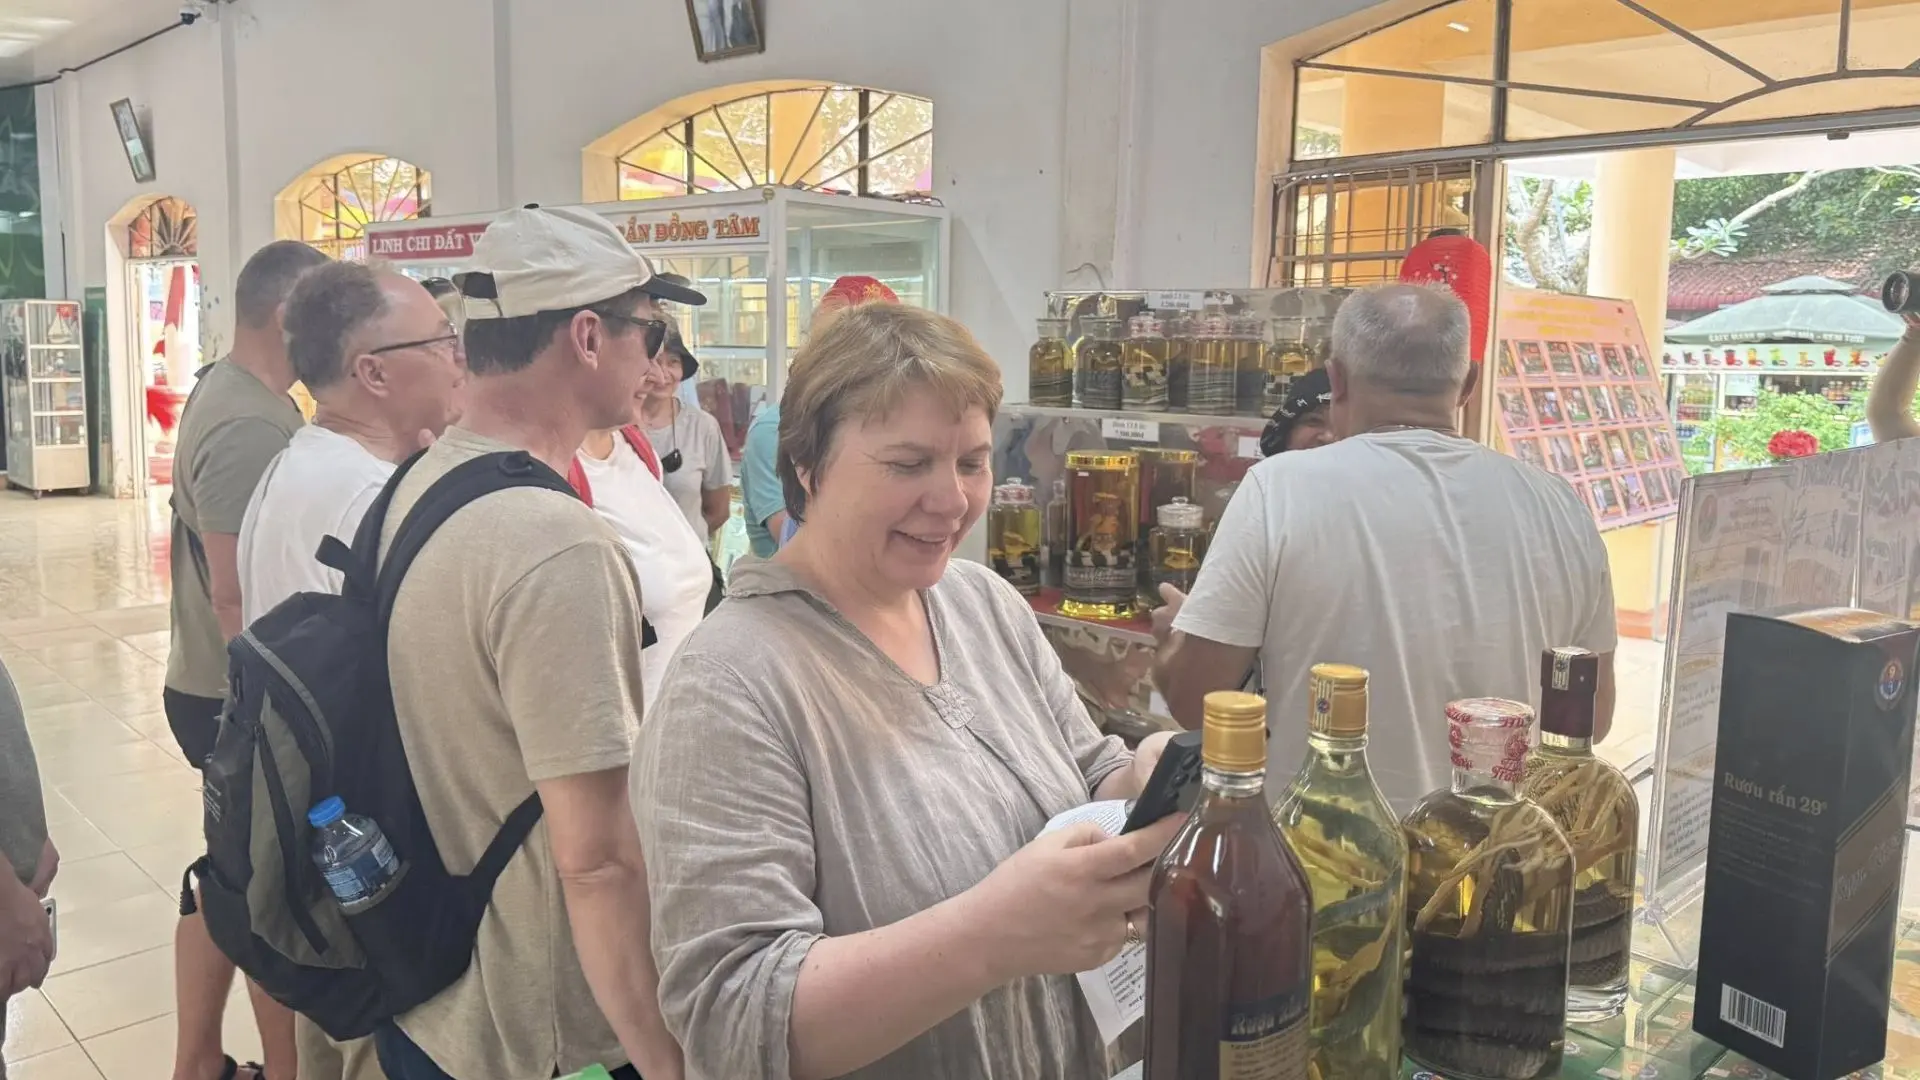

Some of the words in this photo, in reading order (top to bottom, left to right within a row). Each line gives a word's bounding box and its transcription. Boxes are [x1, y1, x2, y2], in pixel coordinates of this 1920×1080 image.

[372, 238, 403, 253] LINH
[406, 235, 431, 251] CHI
[433, 228, 465, 250] ĐẤT
[655, 211, 709, 242] ĐỒNG
[1723, 771, 1763, 799] Rượu
[1769, 784, 1797, 809] rắn
